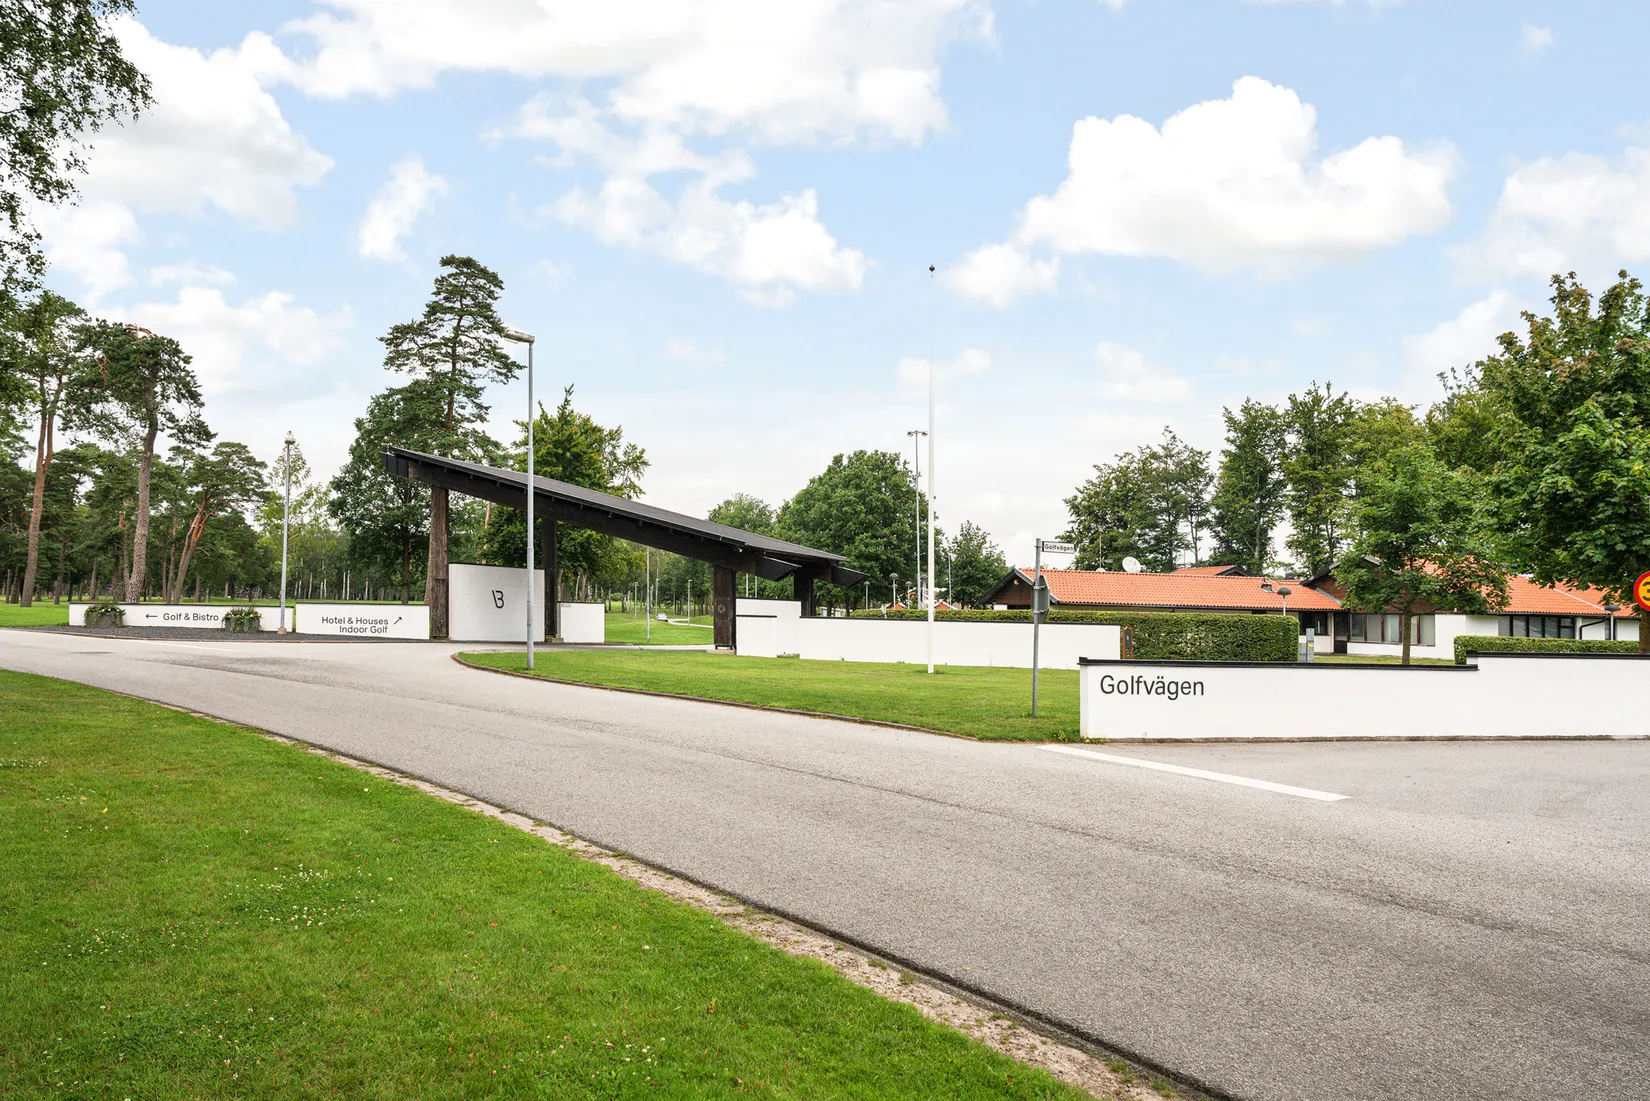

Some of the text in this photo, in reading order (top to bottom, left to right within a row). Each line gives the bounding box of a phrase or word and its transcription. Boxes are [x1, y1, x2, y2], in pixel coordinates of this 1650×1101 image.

[163, 612, 219, 621] Golf & Bistro
[321, 616, 389, 625] Hotel & Houses
[339, 625, 388, 633] Indoor Golf
[1100, 675, 1204, 700] Golfvägen
